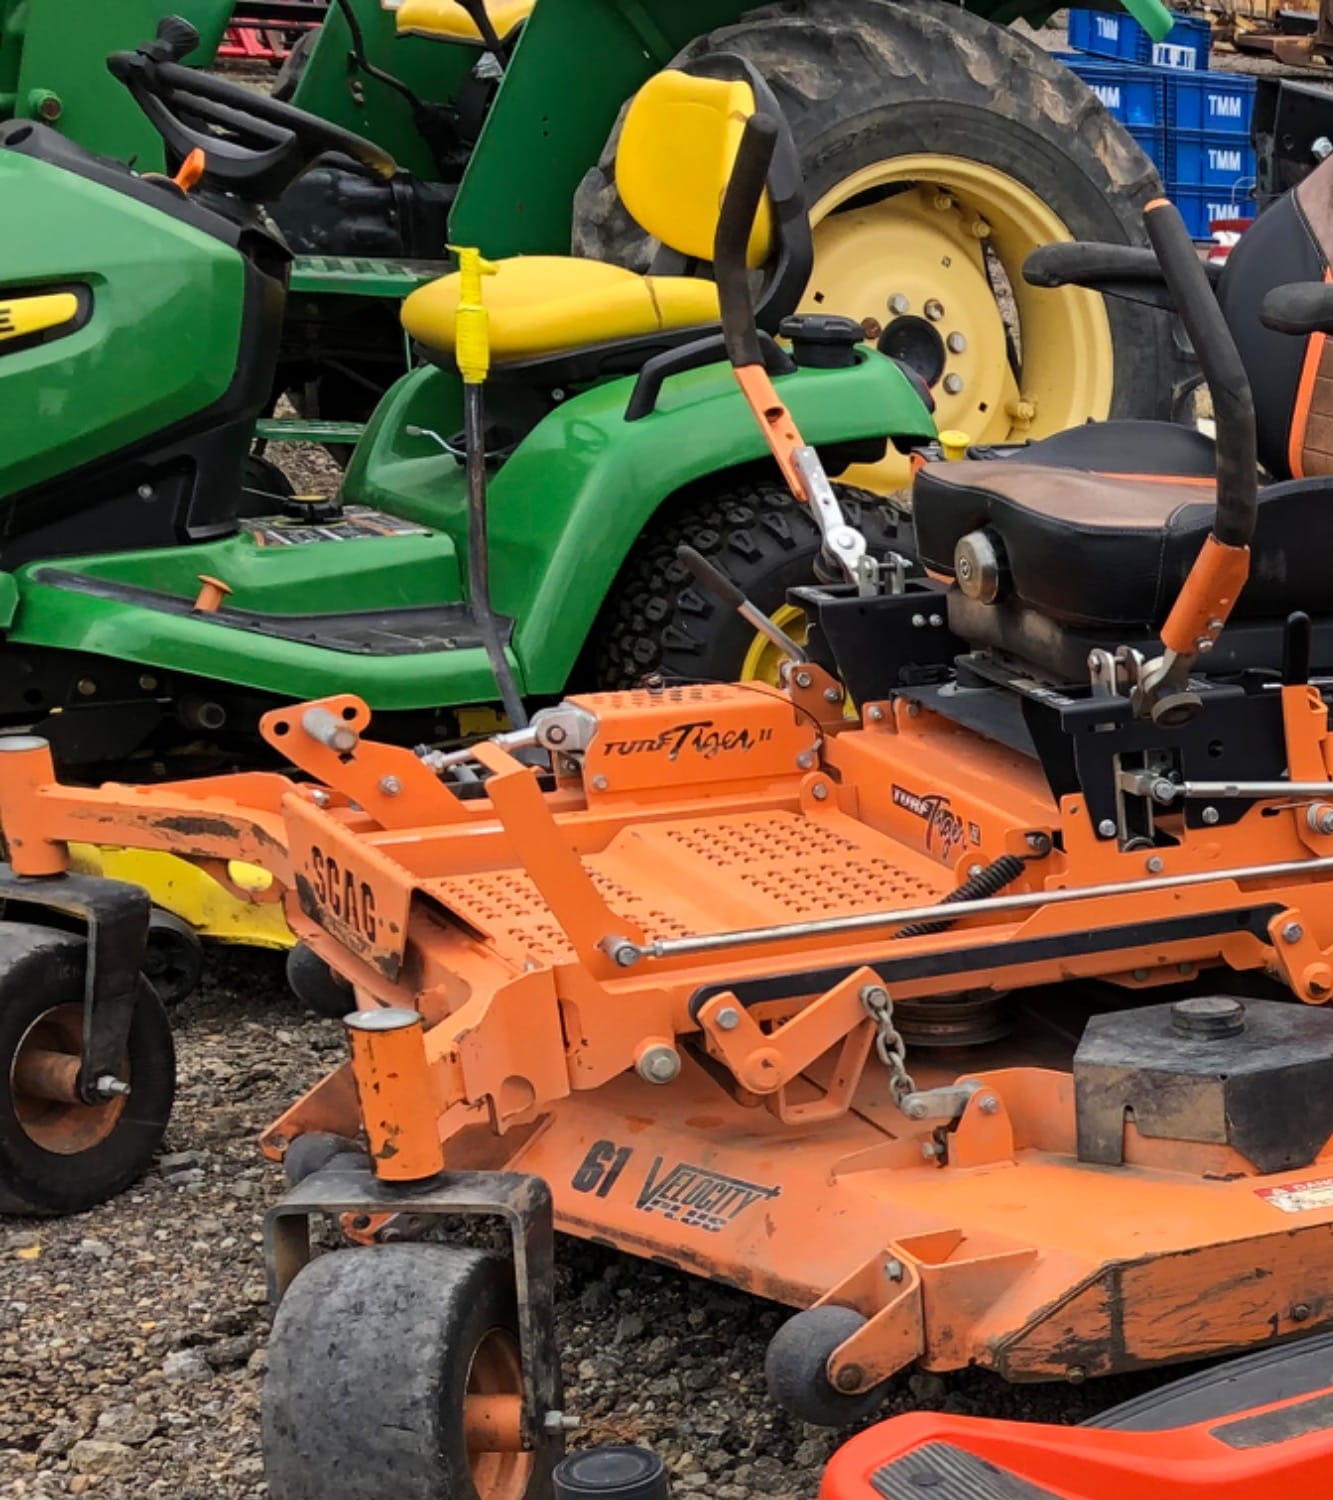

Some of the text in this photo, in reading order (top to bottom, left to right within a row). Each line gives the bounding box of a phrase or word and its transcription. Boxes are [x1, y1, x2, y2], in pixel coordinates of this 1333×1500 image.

[1096, 17, 1118, 41] TMM
[1208, 95, 1241, 117] TMM
[1208, 149, 1241, 171] TMM
[1207, 203, 1240, 222] TMM
[670, 720, 755, 762] Tiger
[312, 846, 375, 943] SCAG
[572, 1139, 768, 1219] 61 VELOCITY
